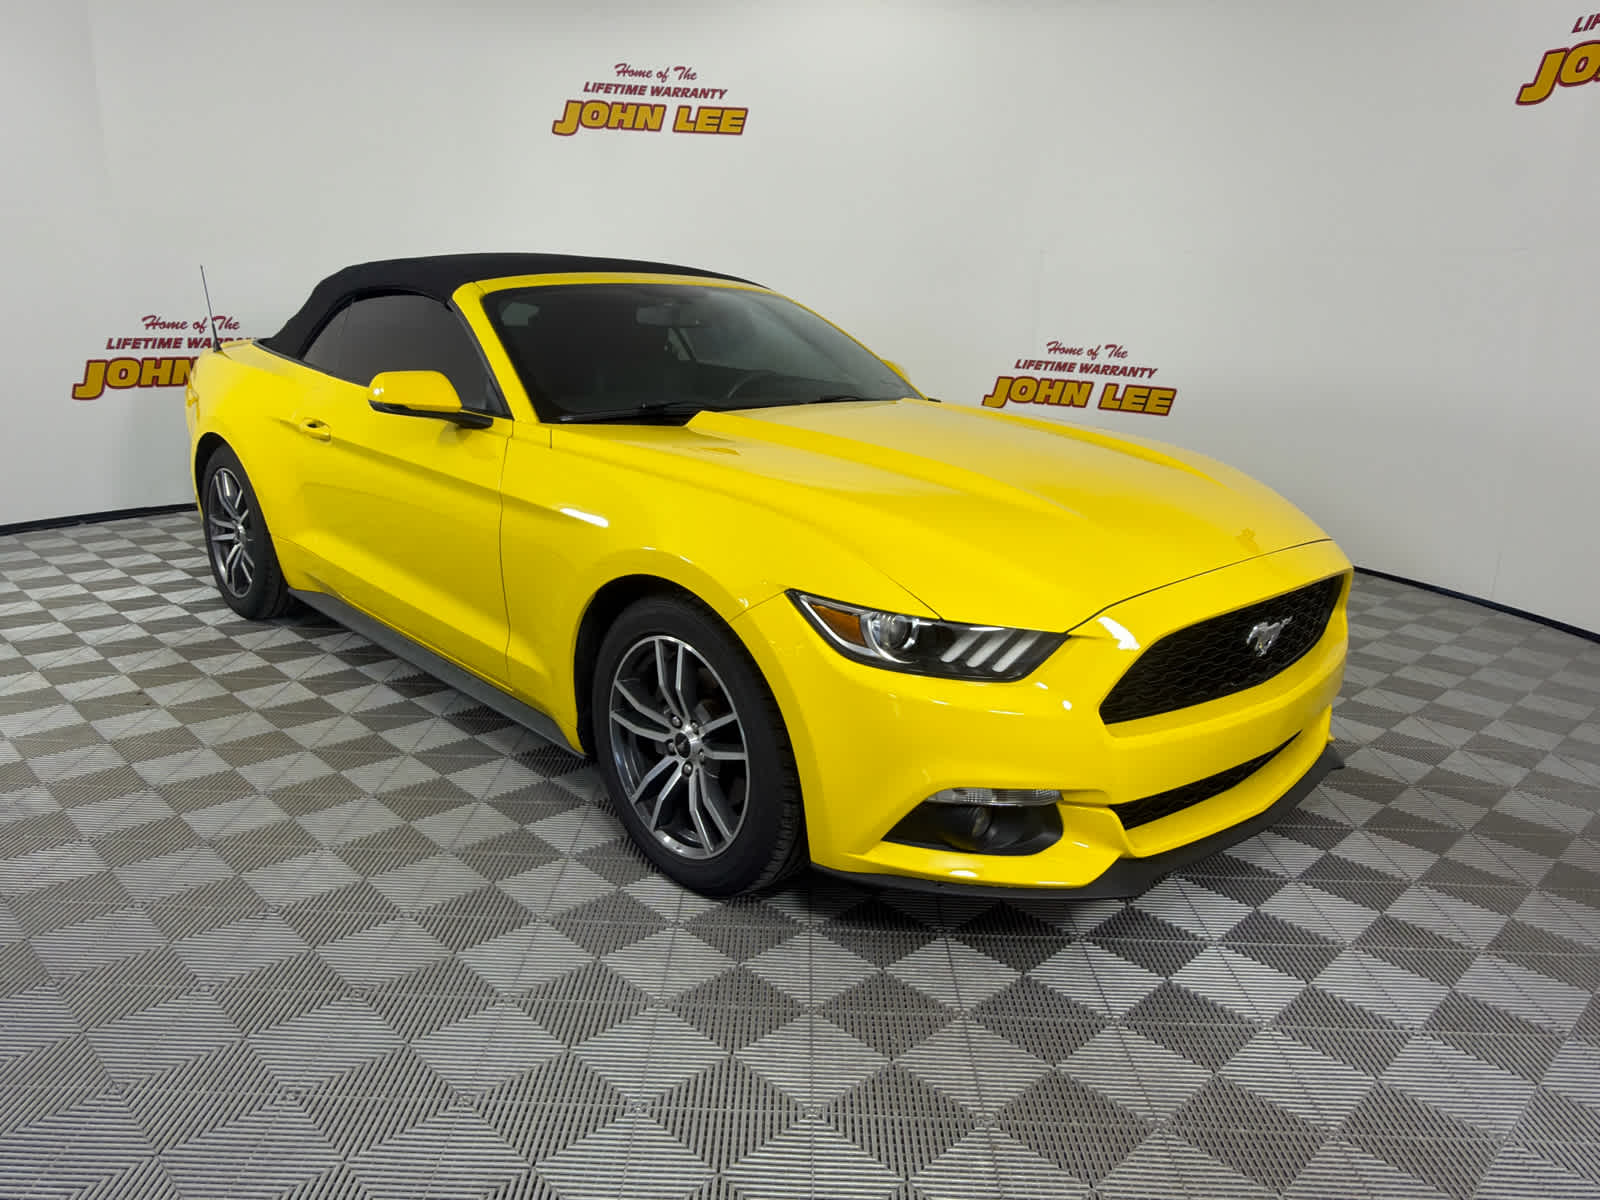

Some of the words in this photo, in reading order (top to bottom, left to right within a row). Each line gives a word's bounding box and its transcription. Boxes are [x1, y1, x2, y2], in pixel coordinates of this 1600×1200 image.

[614, 63, 652, 78] Home
[656, 67, 670, 83] of
[674, 66, 697, 81] The
[1515, 40, 1600, 106] JO
[583, 82, 648, 96] LIFETIME
[650, 86, 727, 100] WARRANTY
[552, 99, 667, 136] JOHN
[672, 105, 749, 136] LEE
[141, 315, 188, 330] Home
[192, 317, 208, 334] of
[212, 315, 240, 330] The
[106, 337, 183, 350] LIFETIME
[1046, 340, 1084, 355] Home
[1087, 345, 1101, 360] of
[1104, 344, 1128, 359] The
[72, 356, 198, 400] JOHN
[1014, 359, 1077, 373] LIFETIME
[1078, 363, 1158, 378] WARRANTY
[981, 376, 1094, 409] JOHN
[1097, 383, 1177, 416] LEE
